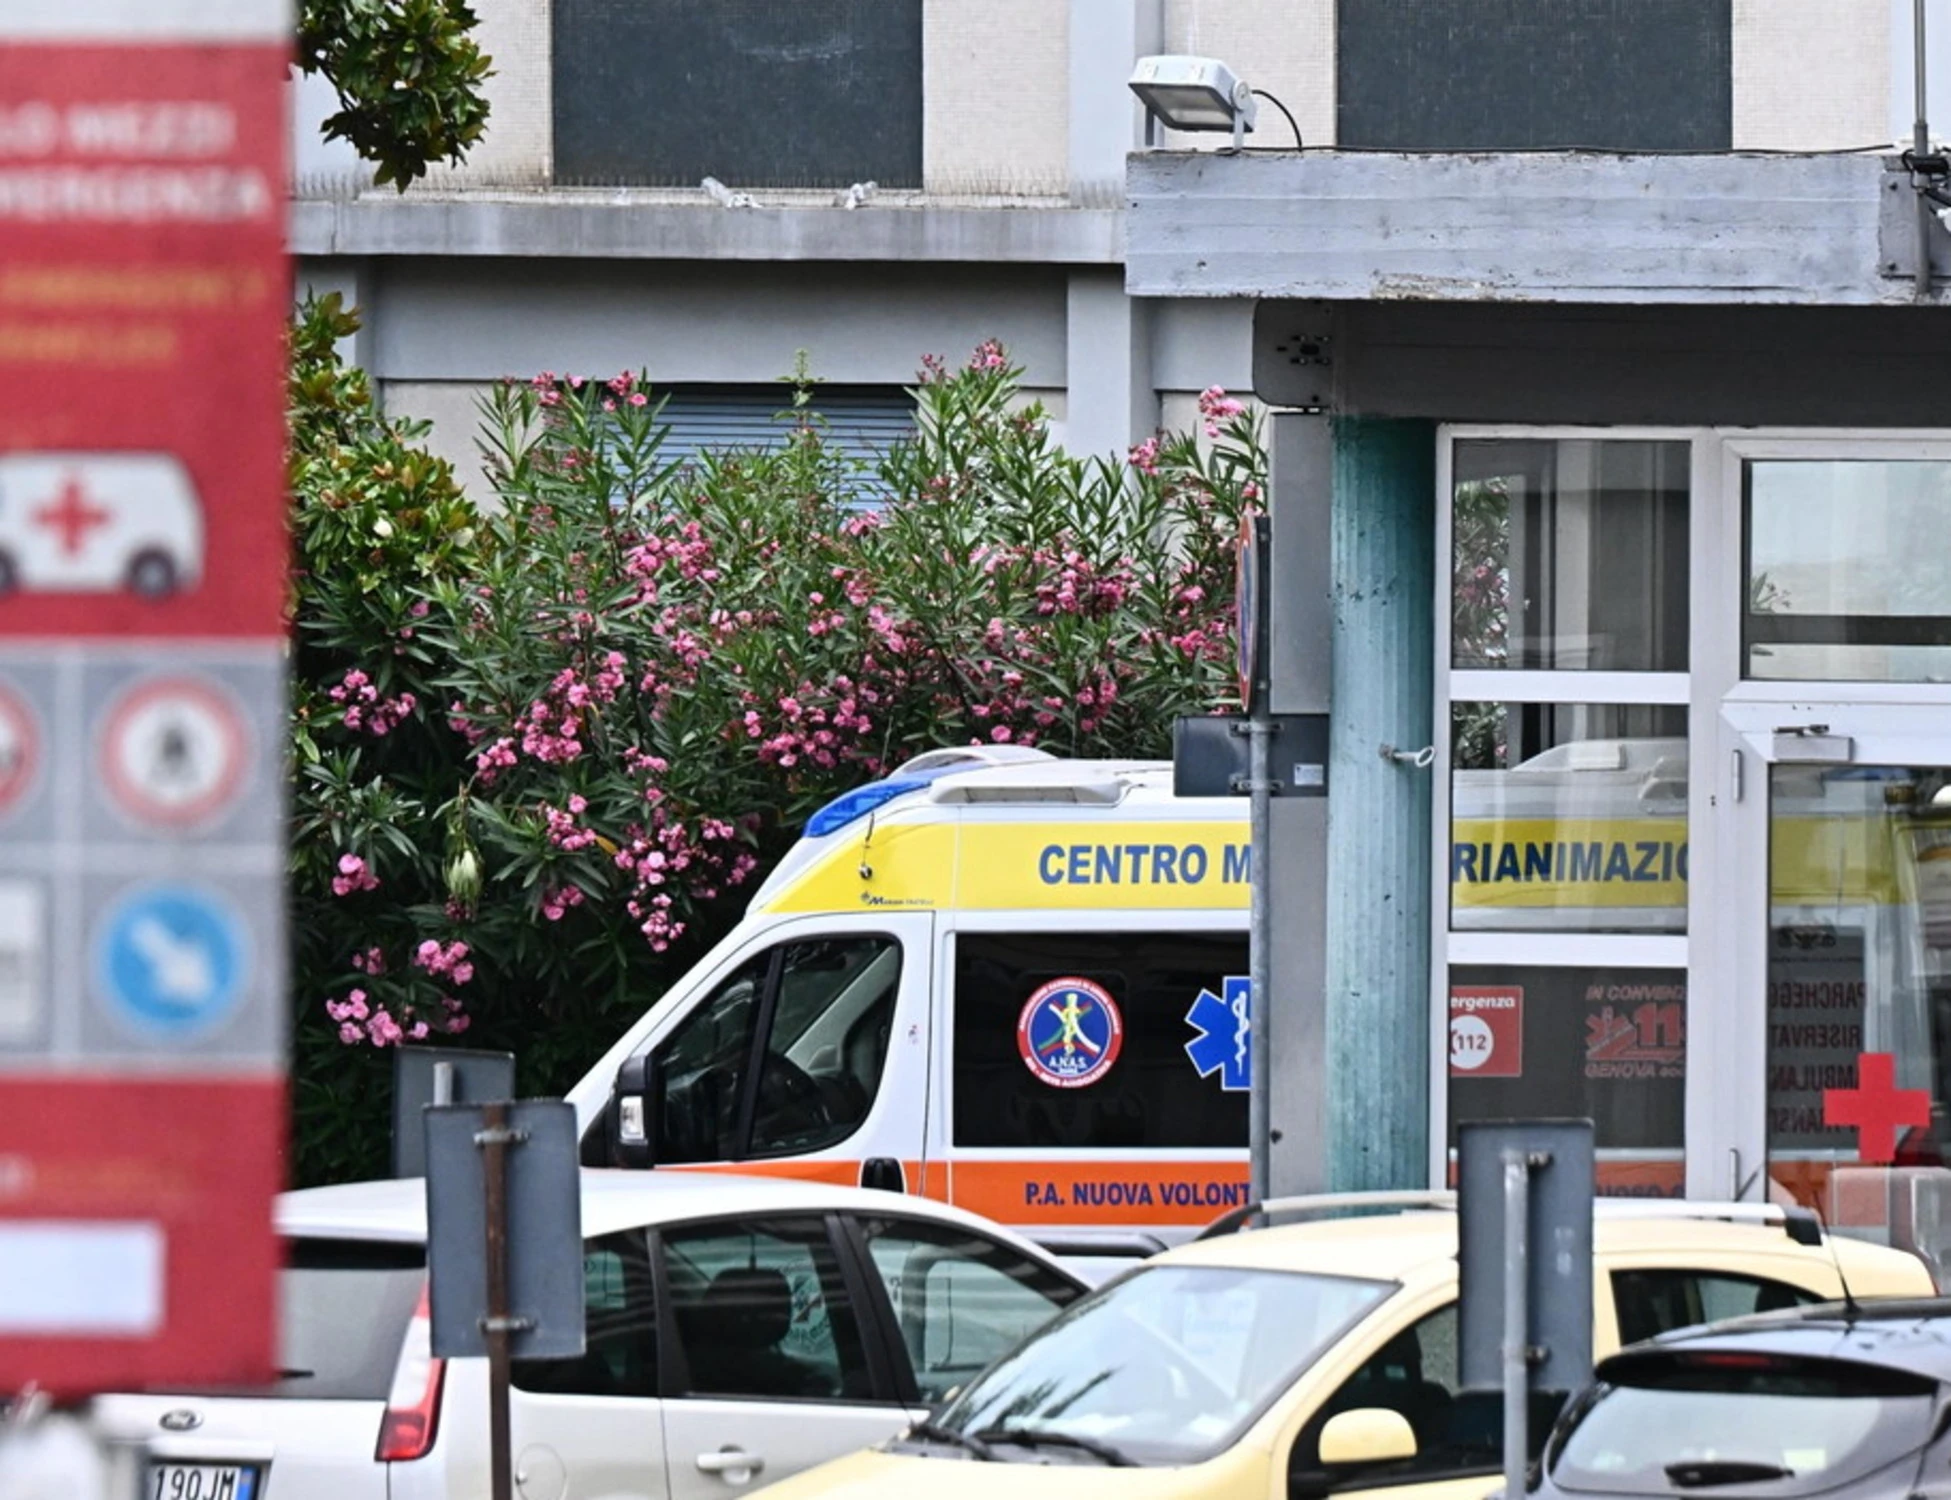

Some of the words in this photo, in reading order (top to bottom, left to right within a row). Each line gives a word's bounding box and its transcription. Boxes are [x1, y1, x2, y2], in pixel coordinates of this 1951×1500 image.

[1039, 844, 1208, 884] CENTRO
[1222, 845, 1251, 883] M
[1457, 1034, 1487, 1051] 112
[1585, 1063, 1655, 1079] GENOVA
[1025, 1182, 1064, 1205] P.A.
[1073, 1183, 1153, 1206] NUOVA
